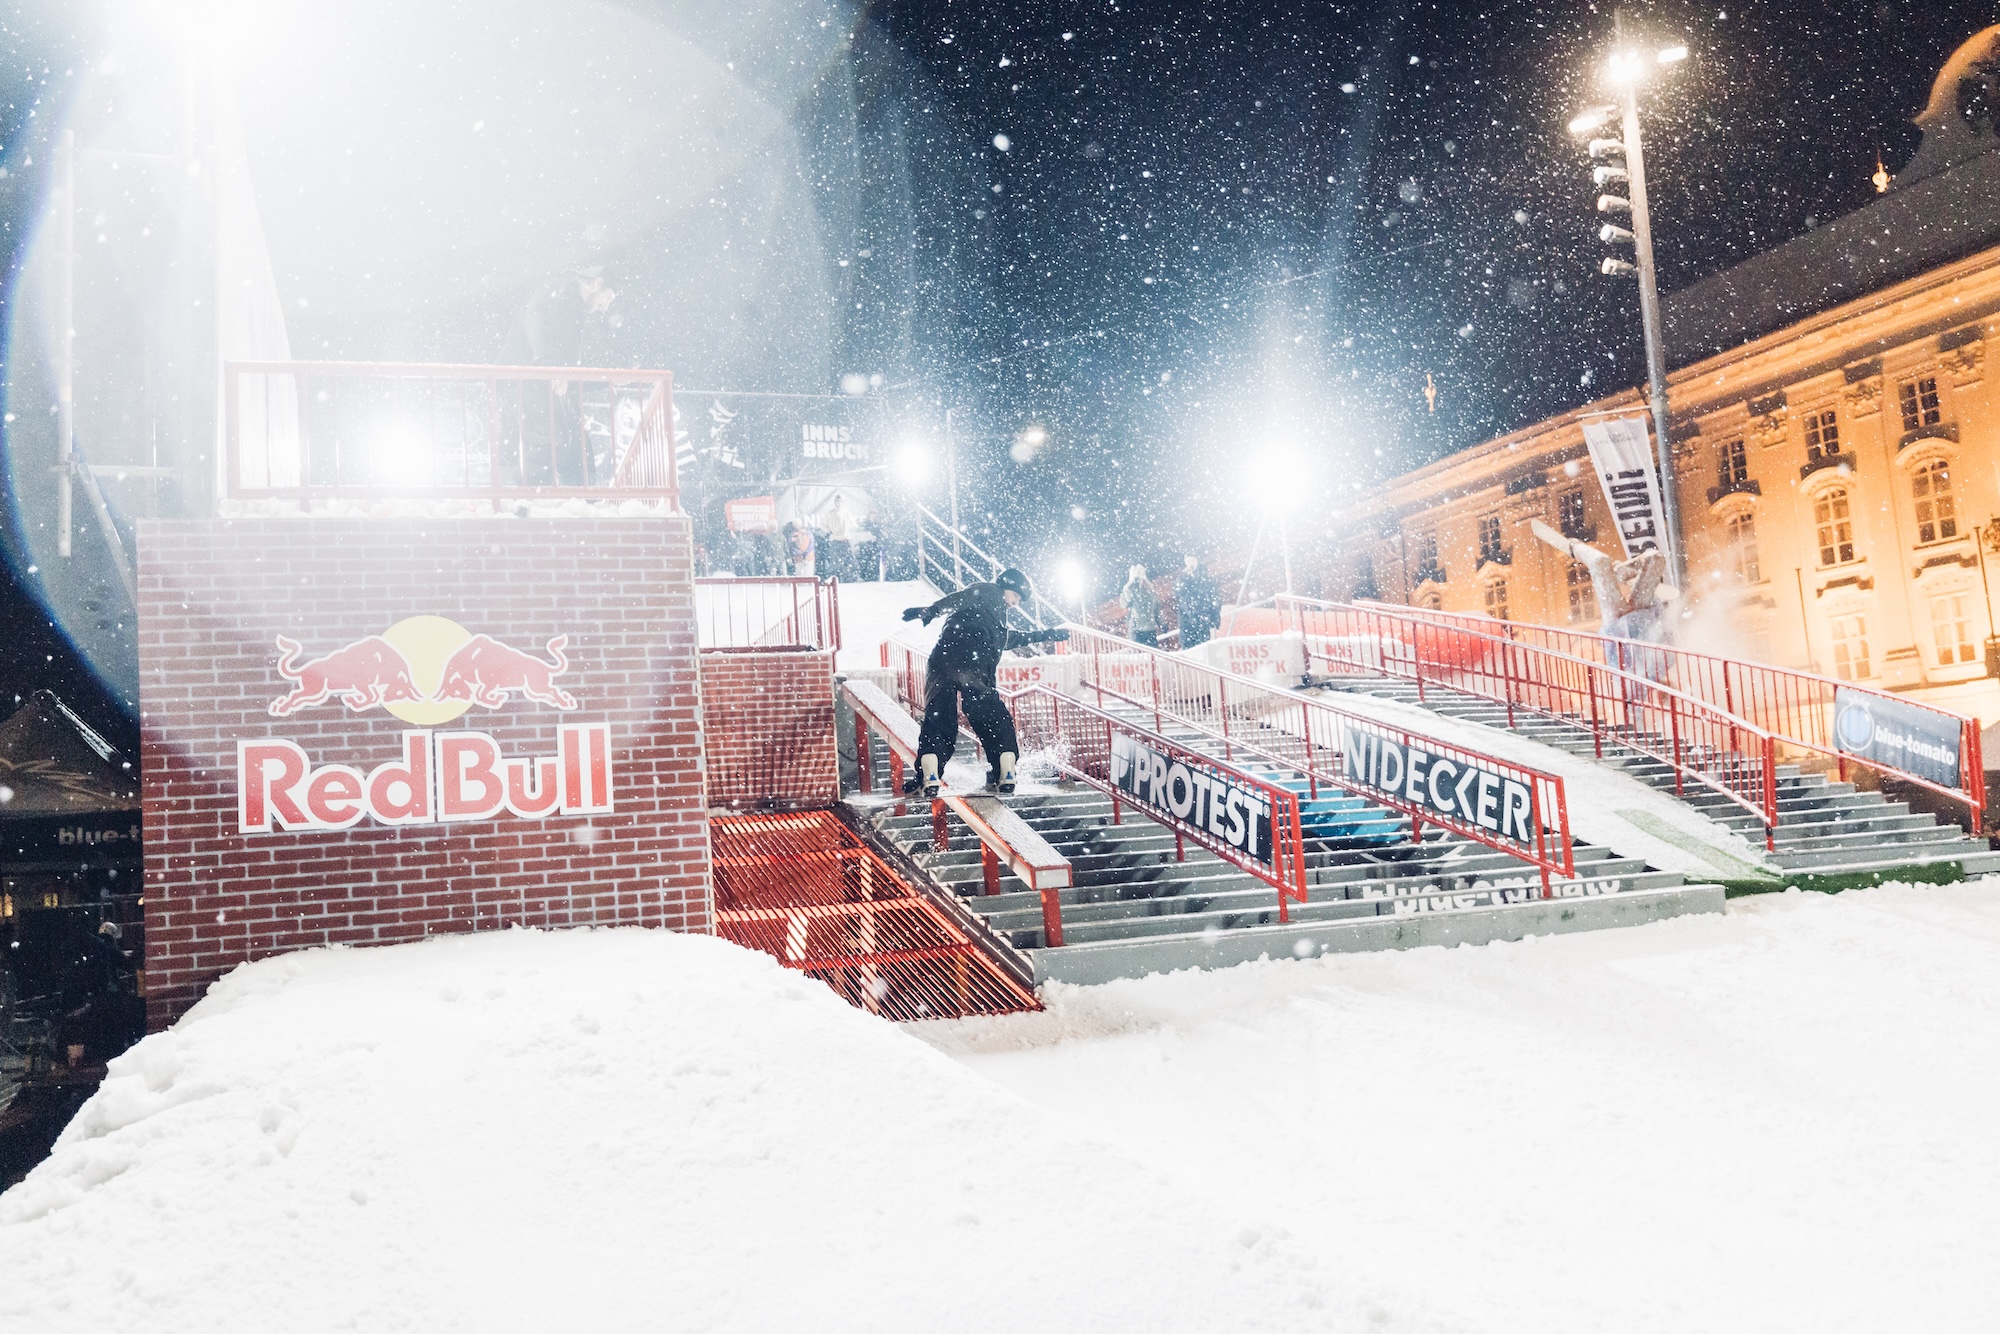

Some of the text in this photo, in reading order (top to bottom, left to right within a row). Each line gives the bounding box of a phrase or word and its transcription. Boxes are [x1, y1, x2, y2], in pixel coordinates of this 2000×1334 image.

[803, 441, 869, 459] BRUCK
[1231, 660, 1286, 674] BRUK
[1875, 725, 1956, 766] blue-tomato
[1342, 726, 1531, 843] NIDECKER
